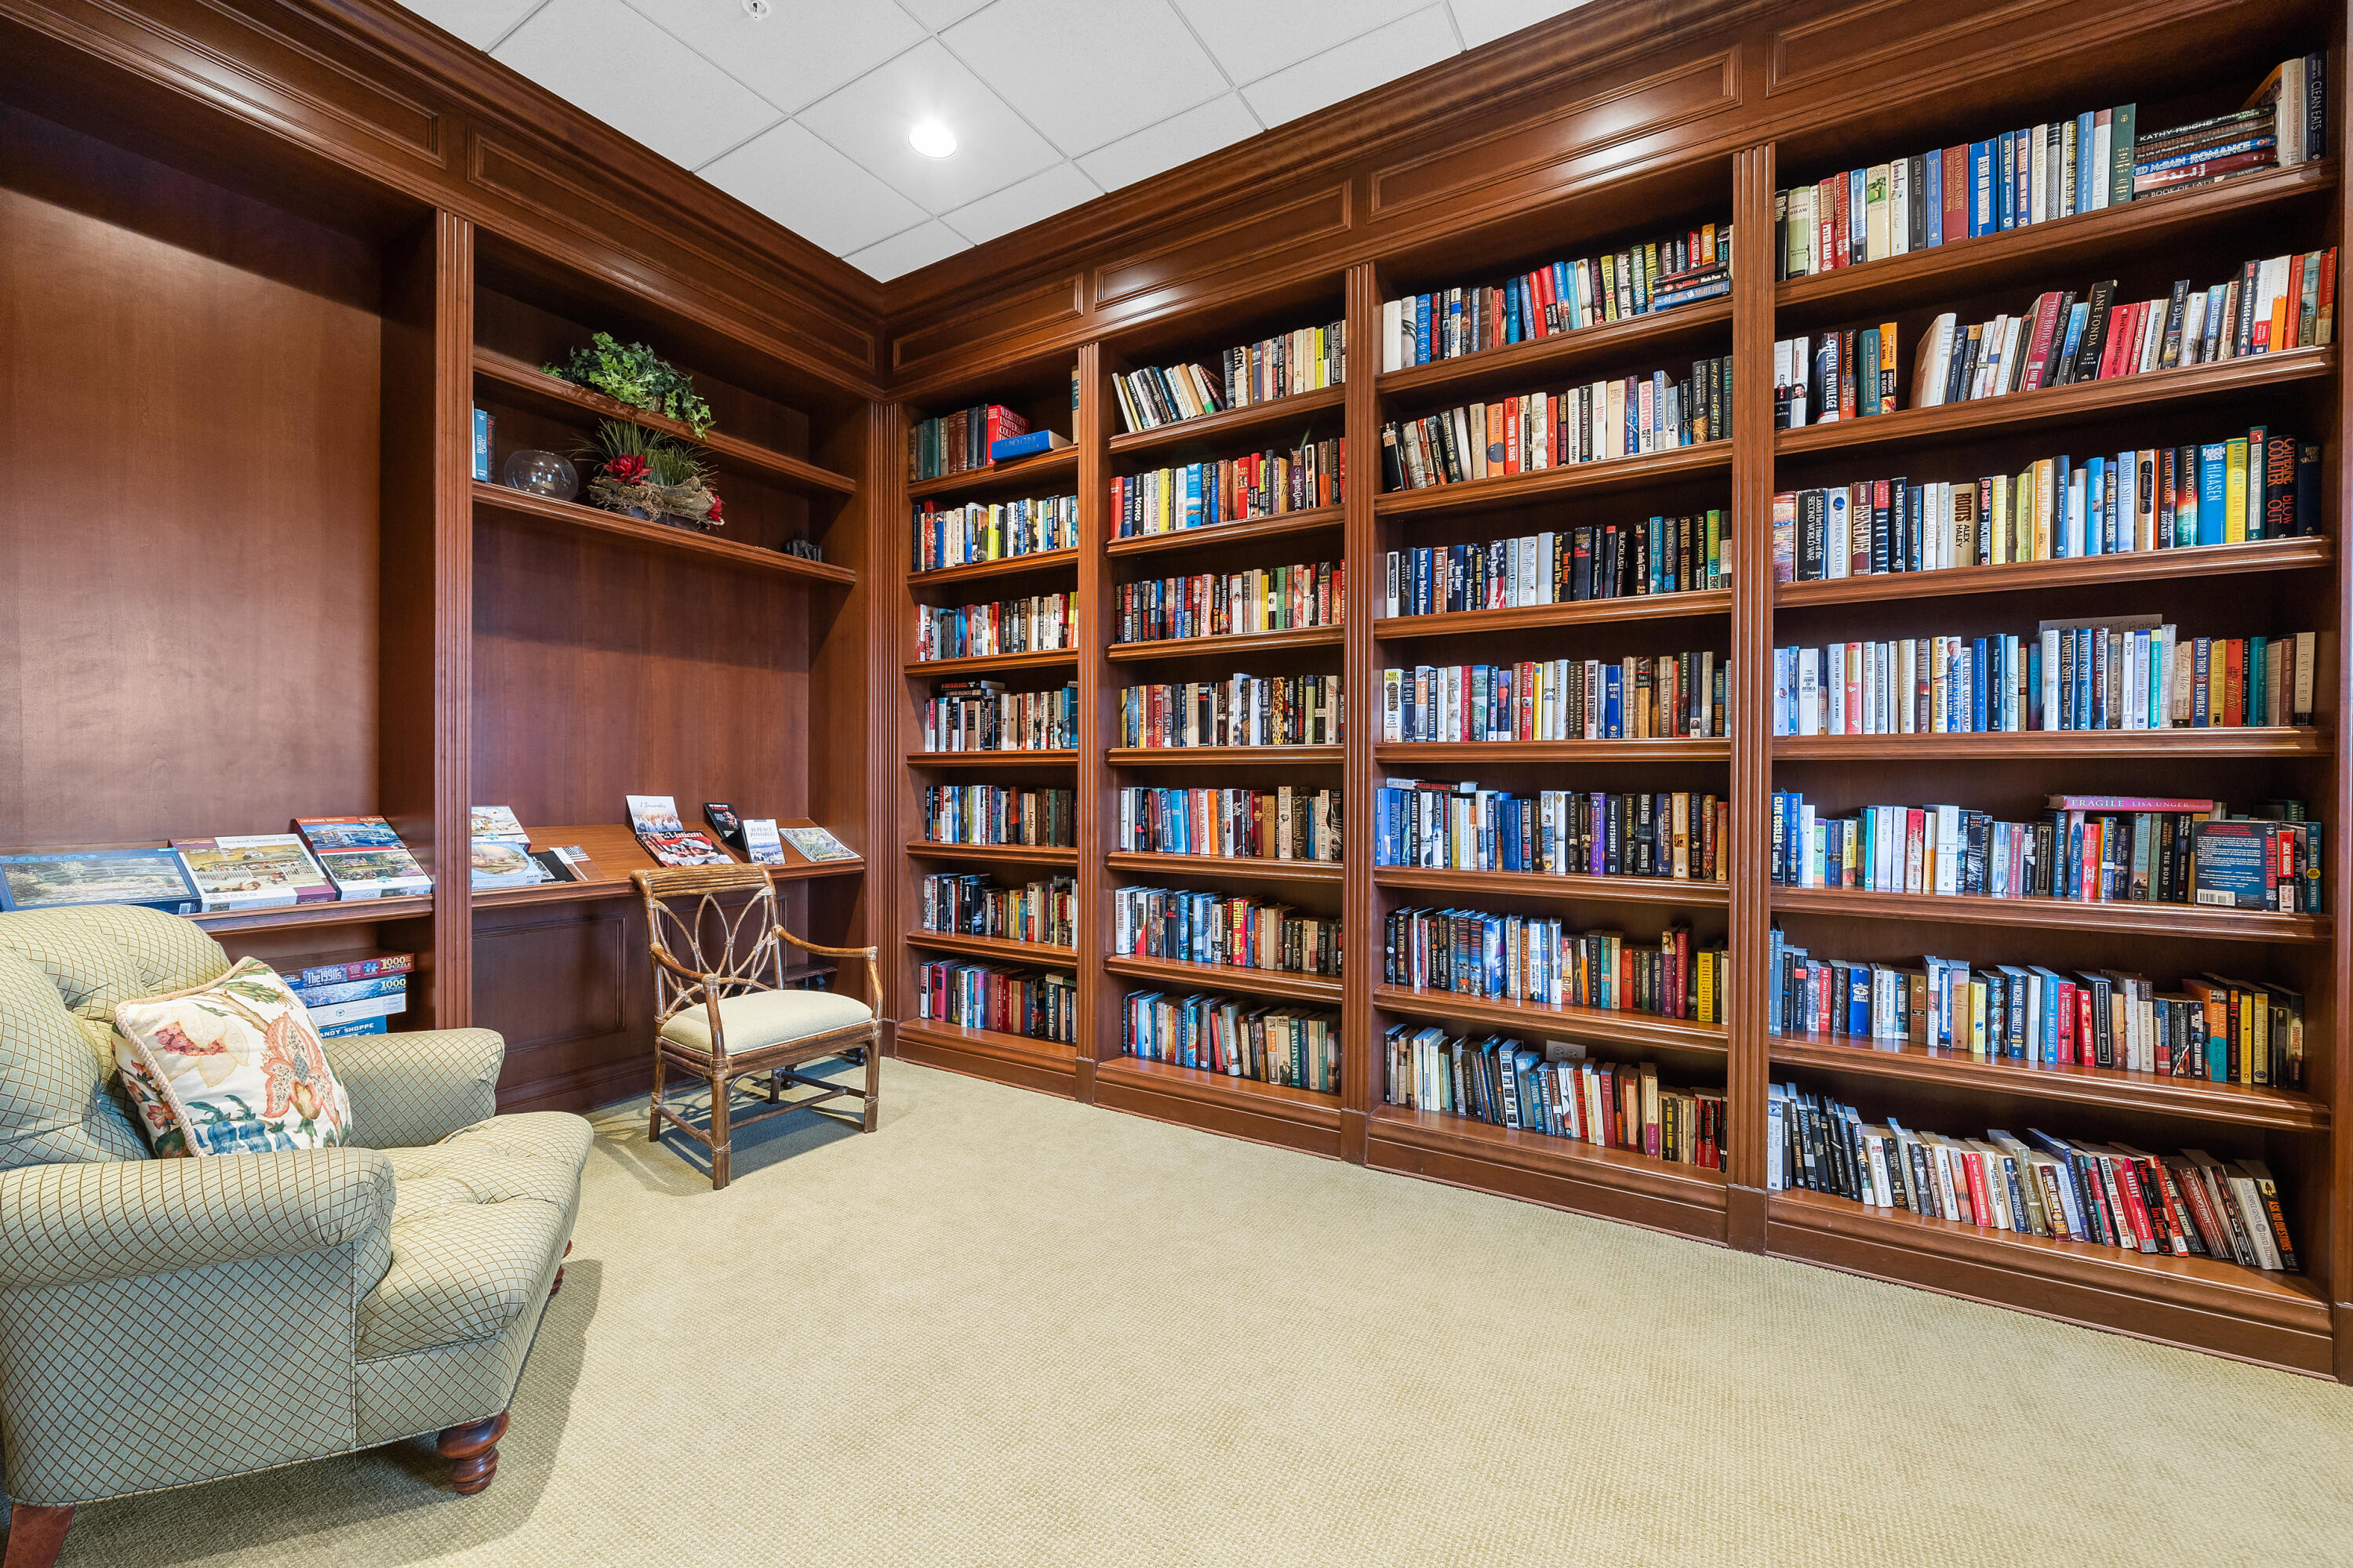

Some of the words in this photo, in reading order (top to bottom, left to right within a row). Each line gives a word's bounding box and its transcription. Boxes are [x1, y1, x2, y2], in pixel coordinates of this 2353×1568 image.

[2311, 81, 2322, 109] CLEAN
[2140, 131, 2171, 142] KATHY
[2173, 120, 2213, 135] REICHS
[2311, 110, 2322, 130] EATS
[1955, 148, 1963, 159] THE
[2136, 167, 2149, 176] ED
[2150, 156, 2187, 173] McBAIN
[2190, 140, 2251, 163] ROMANCE
[1954, 159, 1963, 190] WINDSOR
[1837, 173, 1849, 200] LINDA
[1789, 206, 1809, 216] SHAW
[1954, 191, 1963, 210] STORY
[1838, 202, 1849, 237] HOWARD
[1823, 224, 1831, 243] PETER
[1632, 247, 1643, 268] JAMES
[1823, 244, 1832, 260] MAAS
[1604, 266, 1613, 275] LEE
[1605, 275, 1614, 291] CHILD
[1634, 269, 1646, 305] PATTERSON
[2046, 300, 2058, 318] TOM
[2061, 296, 2072, 315] BILLY
[2093, 289, 2108, 313] JANE
[2243, 294, 2253, 317] HUNGER
[2053, 315, 2068, 349] CRYSTAL
[2087, 315, 2103, 347] FONDA
[2118, 314, 2129, 327] Red
[2242, 318, 2250, 336] GAMES
[2038, 319, 2054, 355] BROKAW
[2115, 327, 2126, 347] Storm
[1827, 340, 1838, 372] OFFICIAL
[2111, 347, 2122, 366] Rising
[1825, 373, 1838, 410] PRIVILEGE
[999, 407, 1026, 427] WEBSTER'S
[1641, 384, 1653, 429] DEIGHTON
[1655, 399, 1664, 428] STRATEGY
[1711, 404, 1721, 424] GUEST
[1711, 426, 1720, 437] LIST
[2164, 452, 2173, 475] STUART
[2268, 441, 2286, 487] COULTER
[2283, 438, 2296, 485] CATHERINE
[2042, 467, 2050, 483] FEEL
[2107, 472, 2116, 486] LOST
[2207, 464, 2222, 502] HIAASEN
[2041, 485, 2050, 511] BETTER
[2107, 488, 2116, 504] HILLS
[2164, 475, 2173, 504] WOODS
[1134, 497, 1143, 521] KOKO
[1806, 496, 1816, 522] SECOND
[1955, 493, 1973, 522] ROOTS
[2106, 505, 2115, 515] LEE
[2268, 500, 2282, 525] OUT
[2282, 496, 2295, 525] BLOW
[1835, 513, 1845, 545] CATHERINE
[1852, 504, 1871, 556] EISENHOWER
[1875, 512, 1888, 537] DARK
[2041, 513, 2049, 529] FAST
[2105, 516, 2115, 543] GOLDBERG
[1806, 522, 1816, 546] WORLD
[1813, 526, 1824, 545] History
[1419, 549, 1428, 561] Tom
[1617, 532, 1626, 569] BLACKLASH
[1806, 547, 1815, 562] WAR
[1835, 546, 1843, 573] COULTER
[1875, 543, 1887, 568] LADY
[1417, 561, 1427, 579] Clancy
[1321, 584, 1329, 623] BUSHWORLD
[2078, 634, 2090, 663] DANIELLE
[2196, 639, 2206, 657] BRAD
[2078, 664, 2090, 682] STEEL
[2196, 657, 2206, 673] THOR
[1587, 675, 1595, 696] TERROR
[2299, 653, 2310, 703] EVICTED
[1587, 697, 1595, 724] NETWORK
[2195, 683, 2206, 717] BLOWBACK
[2078, 708, 2088, 722] Lights
[1773, 796, 1784, 814] CLIVE
[2071, 799, 2125, 810] FRAGILE
[2132, 800, 2156, 811] LISA
[2159, 801, 2190, 811] UNGER
[1609, 820, 1617, 853] OUTSIDERS
[1773, 816, 1784, 843] CUSSLER
[2266, 835, 2277, 856] JAMES
[2282, 842, 2292, 856] JACK
[2162, 867, 2170, 886] ROAD
[2265, 857, 2277, 889] PATTERSON
[2282, 856, 2292, 876] HIGGINS
[1233, 901, 1245, 929] Griffin
[380, 956, 406, 970] 1000
[307, 972, 320, 984] The
[320, 969, 342, 983] 1990's
[381, 979, 406, 988] 1000
[2013, 984, 2024, 1006] MICHAEL
[318, 1029, 341, 1038] ANDY
[344, 1023, 374, 1032] SHOPPE
[2011, 1008, 2022, 1033] CONNELLY
[1799, 1110, 1810, 1135] KARMA
[2100, 1159, 2114, 1185] PLAYMATES
[2110, 1194, 2122, 1213] ROBERT
[2118, 1219, 2129, 1238] PARKER
[2268, 1201, 2280, 1213] ASK
[2271, 1213, 2284, 1221] NO
[2274, 1221, 2293, 1252] QUESTIONS
